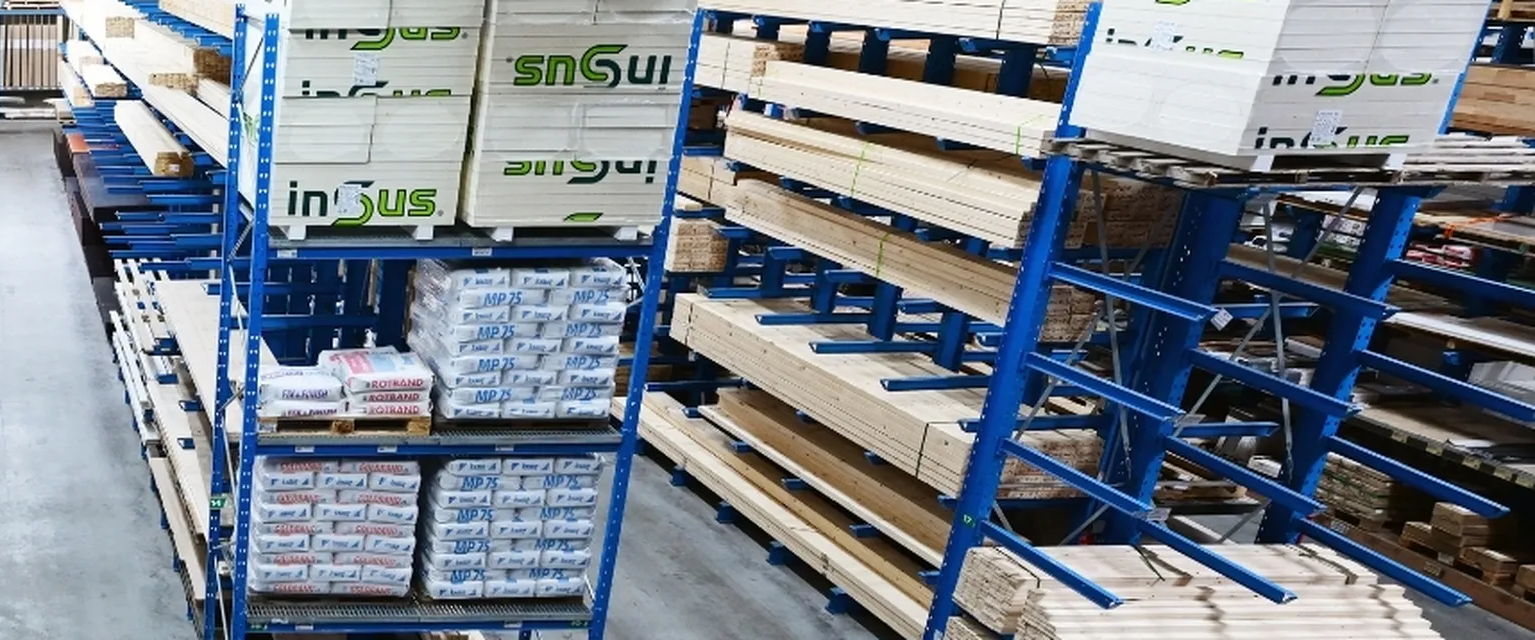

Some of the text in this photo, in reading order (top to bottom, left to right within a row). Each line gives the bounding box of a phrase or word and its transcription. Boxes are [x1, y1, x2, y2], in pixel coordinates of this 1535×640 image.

[484, 292, 522, 305] MP 75
[574, 291, 596, 304] MP
[477, 326, 515, 339] MP 75
[566, 324, 588, 336] MP
[478, 358, 515, 371] MP 75
[476, 390, 511, 403] MP 75
[461, 476, 499, 489] MP 75
[544, 475, 579, 488] MP 75
[457, 509, 493, 522] MP 75
[540, 508, 575, 520] MP 75
[454, 541, 490, 553] MP 75
[535, 539, 569, 550] MP 75
[451, 570, 485, 583] MP 75
[529, 568, 563, 579] MP 75
